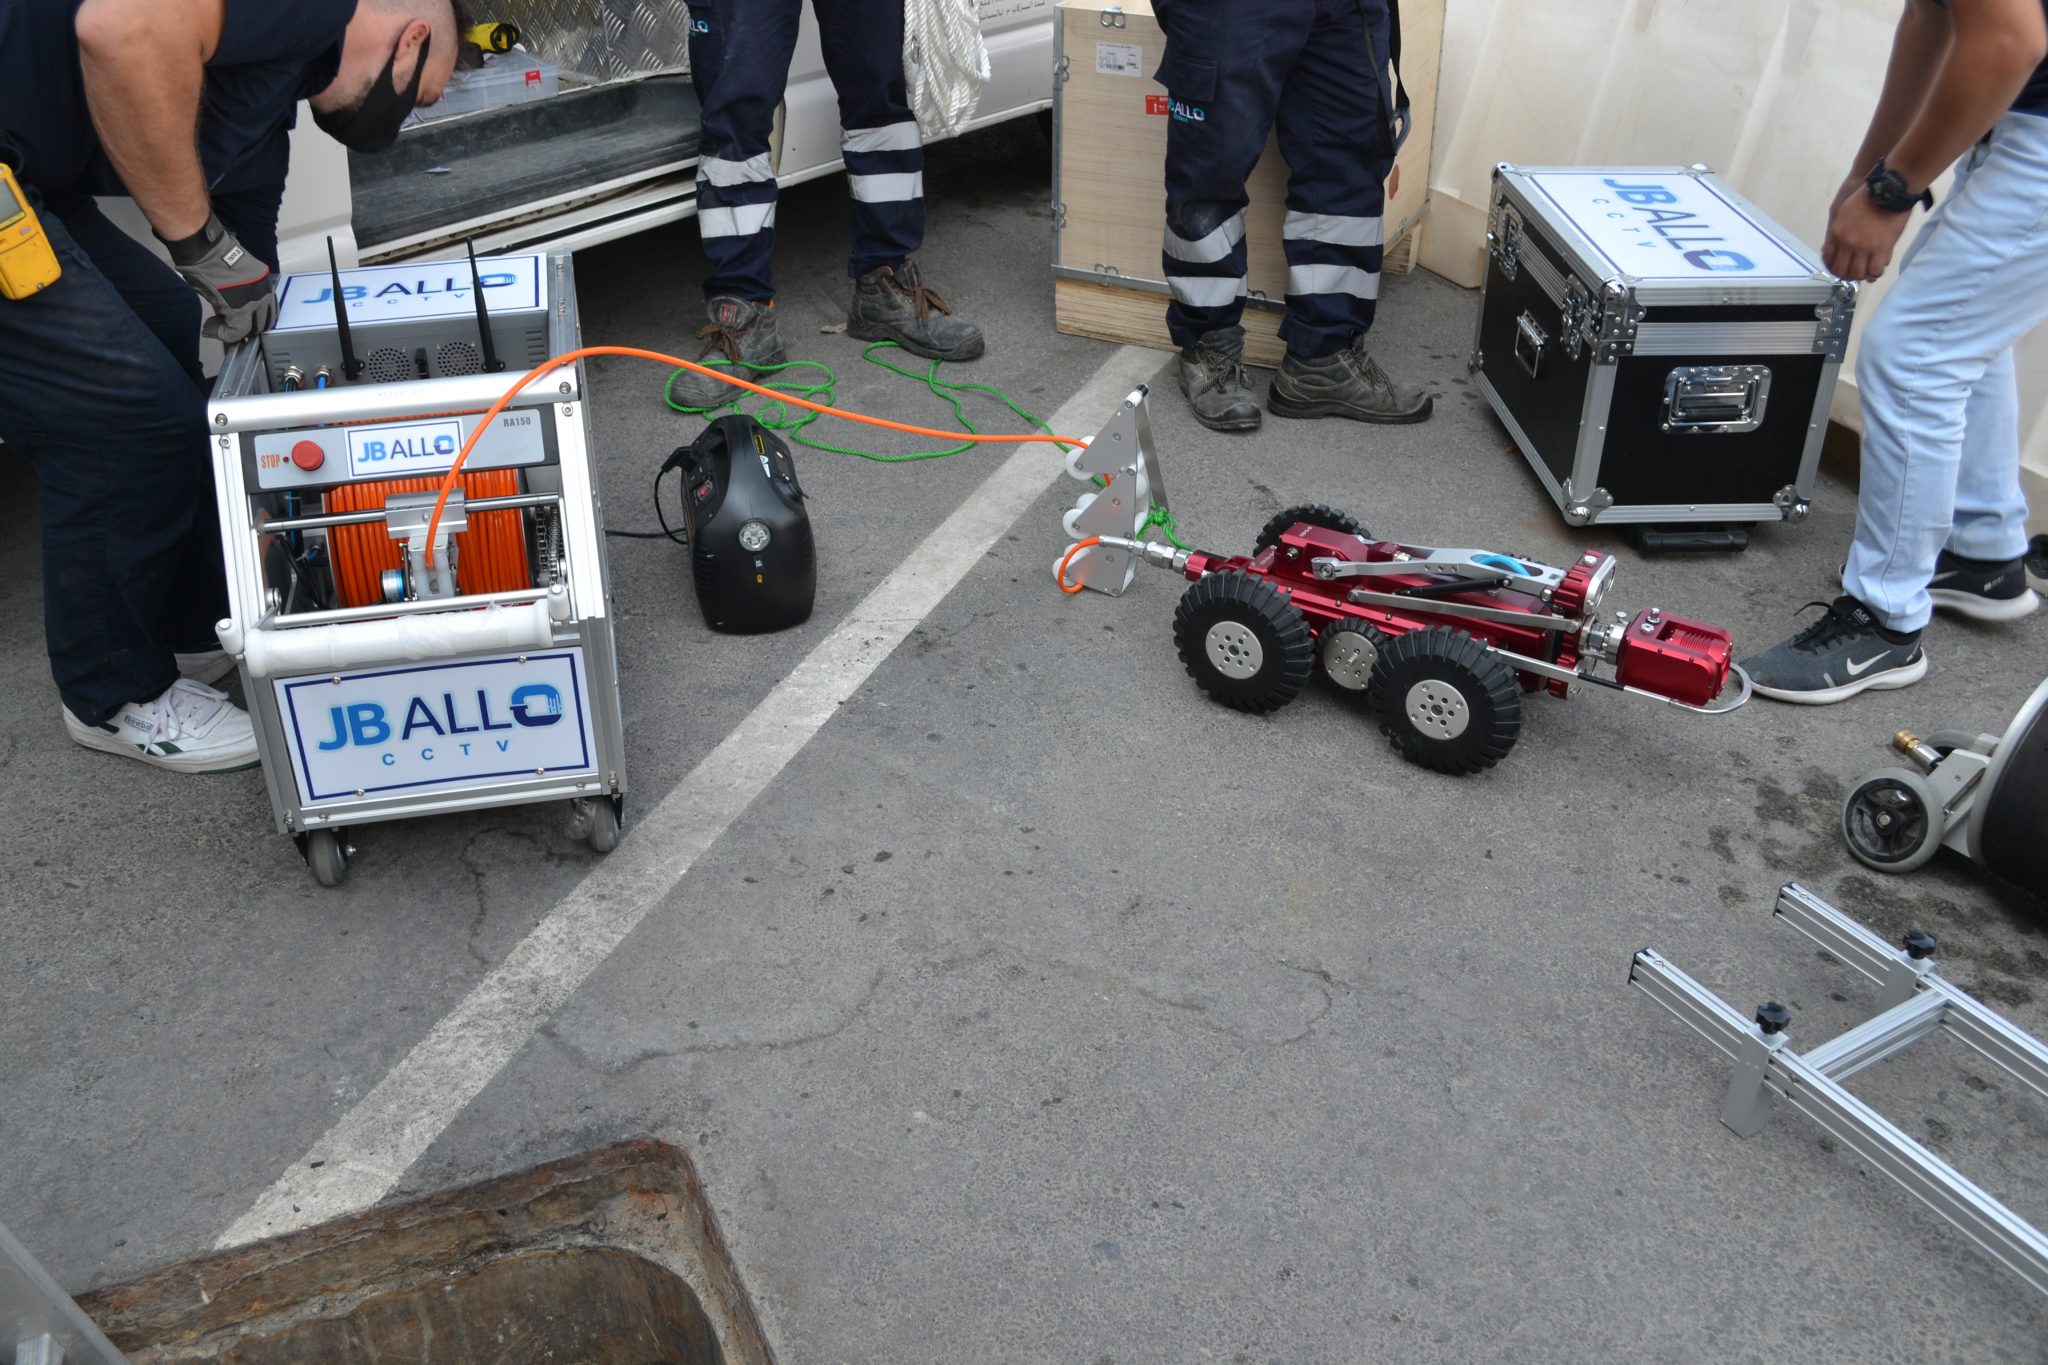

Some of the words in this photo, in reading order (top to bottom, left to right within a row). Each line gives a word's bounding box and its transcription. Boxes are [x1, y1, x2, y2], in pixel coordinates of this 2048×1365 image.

[1592, 198, 1657, 248] CCTV
[352, 293, 465, 308] CCTV
[503, 416, 531, 428] RA150
[261, 454, 281, 469] STOP
[124, 715, 154, 730] Reebo
[381, 739, 509, 766] CCTV
